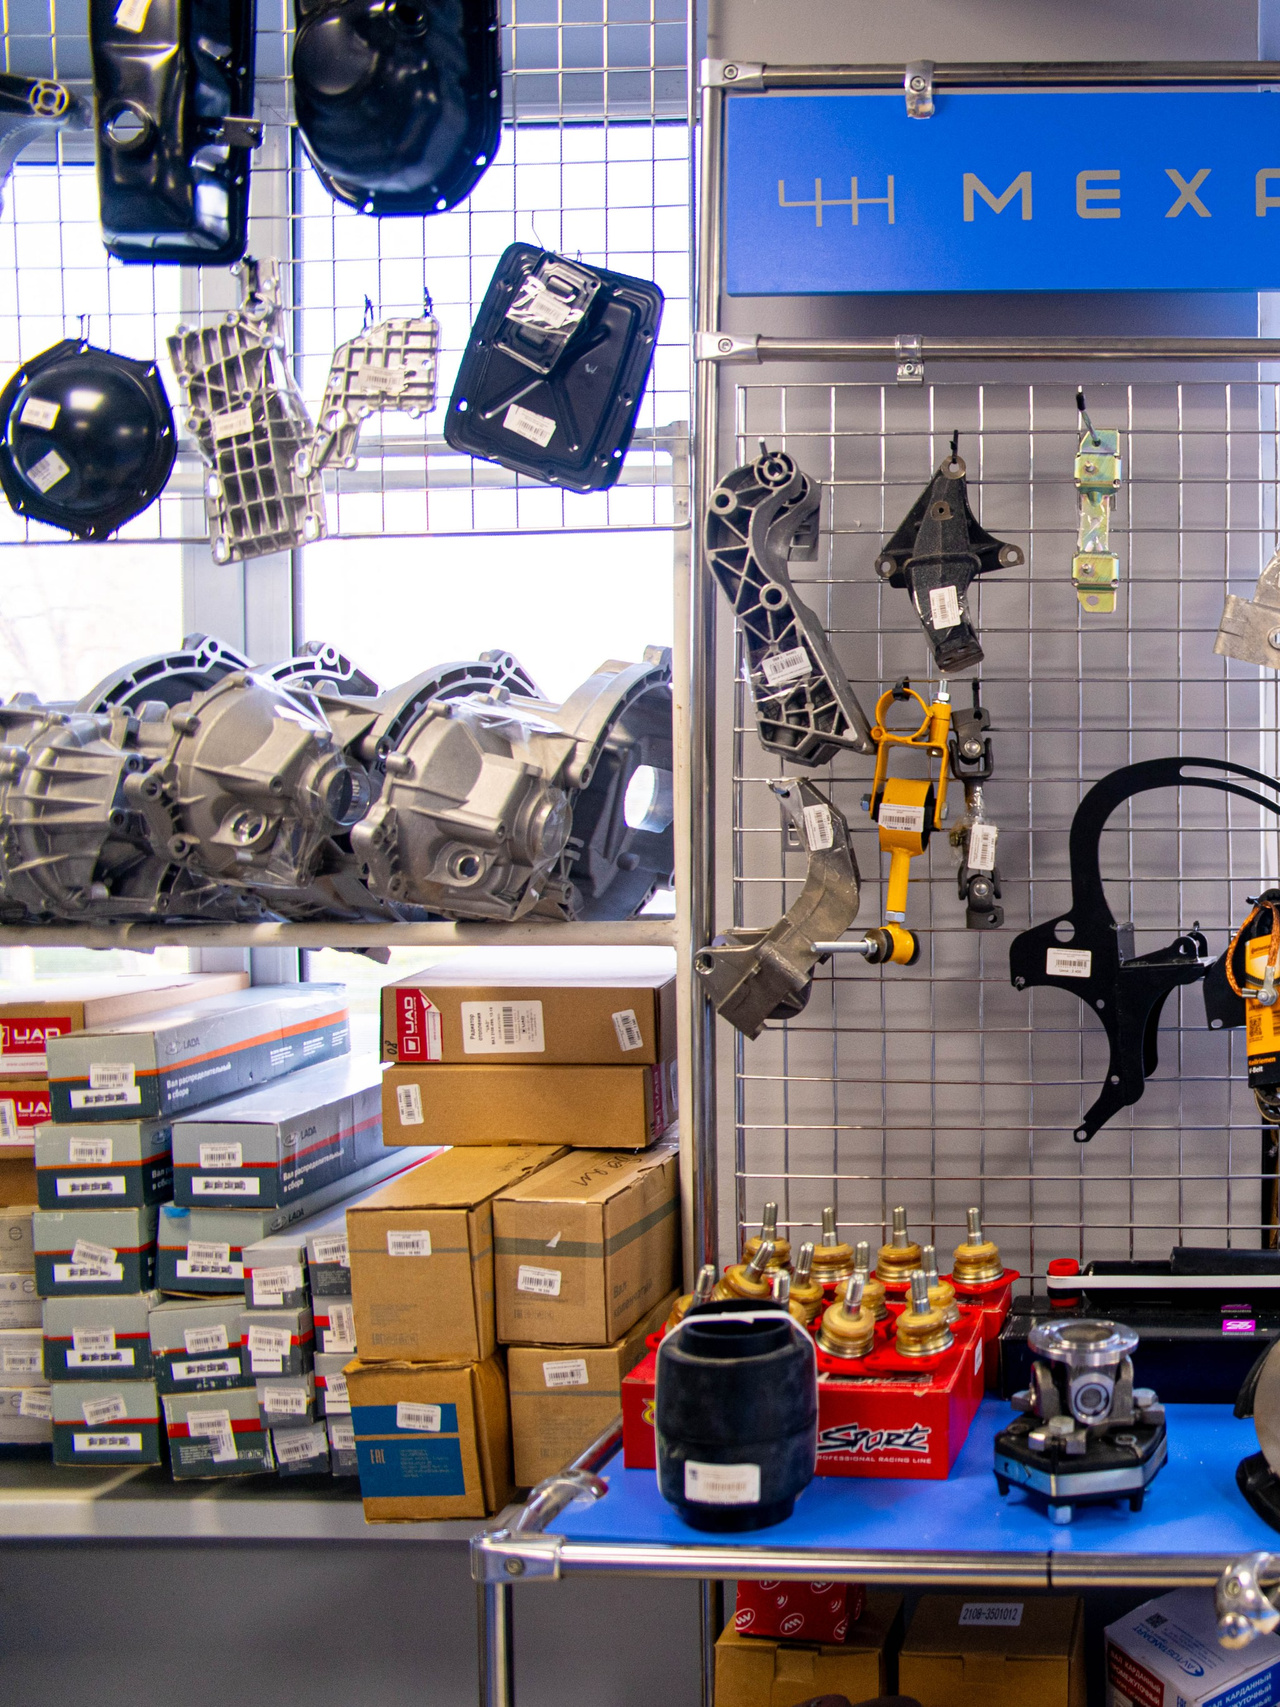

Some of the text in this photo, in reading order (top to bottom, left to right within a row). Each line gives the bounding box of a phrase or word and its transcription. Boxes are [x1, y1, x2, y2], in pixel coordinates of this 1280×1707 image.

[404, 997, 414, 1034] UAD
[13, 1028, 61, 1040] UAD
[183, 1037, 200, 1050] LADA
[166, 1061, 231, 1090] Вал распределительный
[172, 1088, 189, 1099] сборе
[17, 1101, 51, 1113] UA
[301, 1126, 317, 1140] LADA
[283, 1148, 344, 1181] Вал распределительный
[288, 1178, 304, 1191] сборе
[288, 1208, 304, 1223] LADA
[963, 1608, 1018, 1620] 2108-3501012
[1124, 1658, 1161, 1693] КАРДАННЫЙ
[1225, 1672, 1272, 1702] КАРДАННЫЙ
